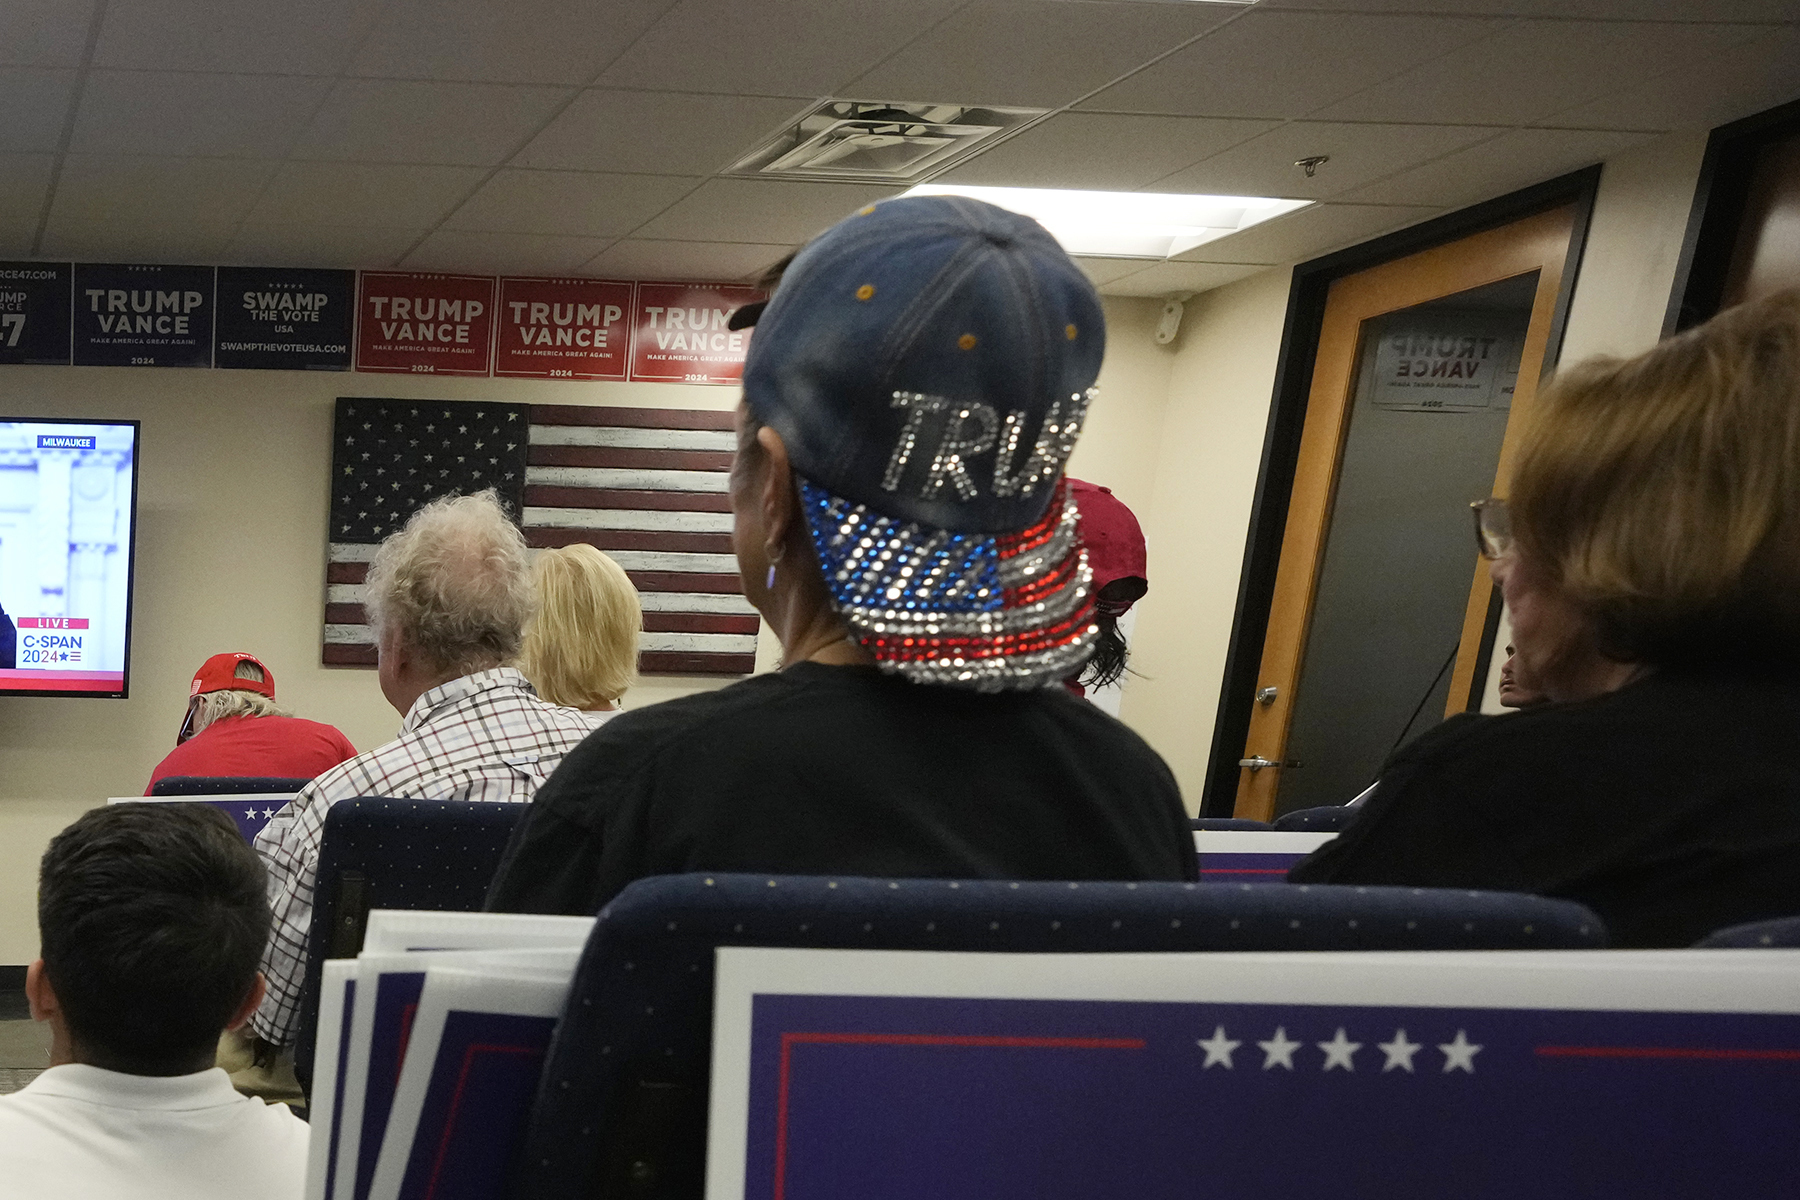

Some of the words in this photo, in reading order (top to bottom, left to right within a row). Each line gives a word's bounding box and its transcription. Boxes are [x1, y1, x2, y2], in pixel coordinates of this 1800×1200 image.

[85, 288, 203, 313] TRUMP
[242, 292, 328, 311] SWAMP
[251, 310, 277, 321] THE
[282, 311, 320, 322] VOTE
[369, 297, 484, 322] TRUMP
[509, 301, 622, 327] TRUMP
[97, 314, 189, 334] VANCE
[645, 307, 734, 331] TRUM
[274, 325, 294, 334] USA
[380, 322, 469, 343] VANCE
[520, 327, 608, 348] VANCE
[656, 332, 743, 352] VANCE
[221, 342, 346, 354] SWAMPTHEVOTEUSA.COM
[131, 357, 155, 365] 2024
[412, 364, 435, 373] 2024
[549, 369, 572, 377] 2024
[685, 374, 708, 382] 2024
[41, 436, 92, 449] MILWAUKEE
[37, 618, 70, 629] LIVE
[22, 649, 58, 663] 2024
